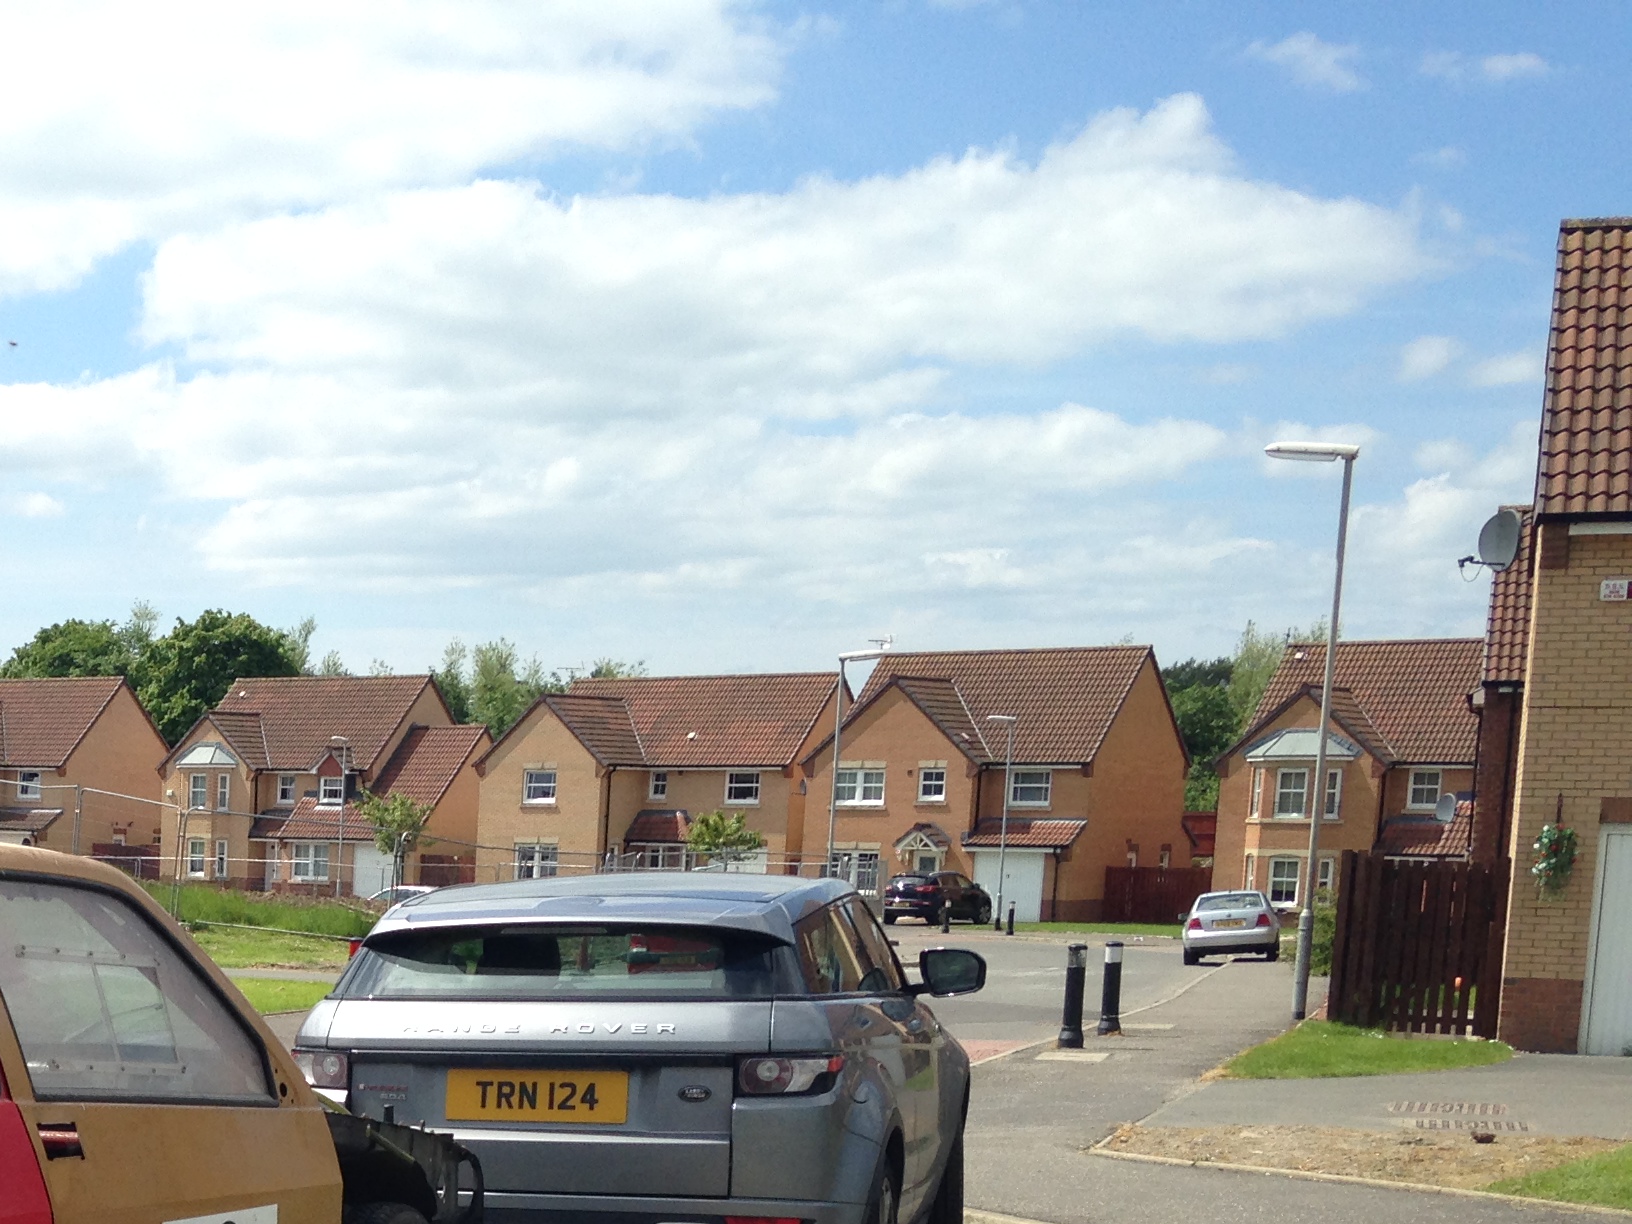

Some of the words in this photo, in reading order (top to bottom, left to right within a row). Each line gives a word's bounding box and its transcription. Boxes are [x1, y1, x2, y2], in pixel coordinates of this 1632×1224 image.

[549, 1022, 677, 1035] ROVER
[475, 1080, 538, 1110] TRN
[547, 1081, 599, 1111] 124
